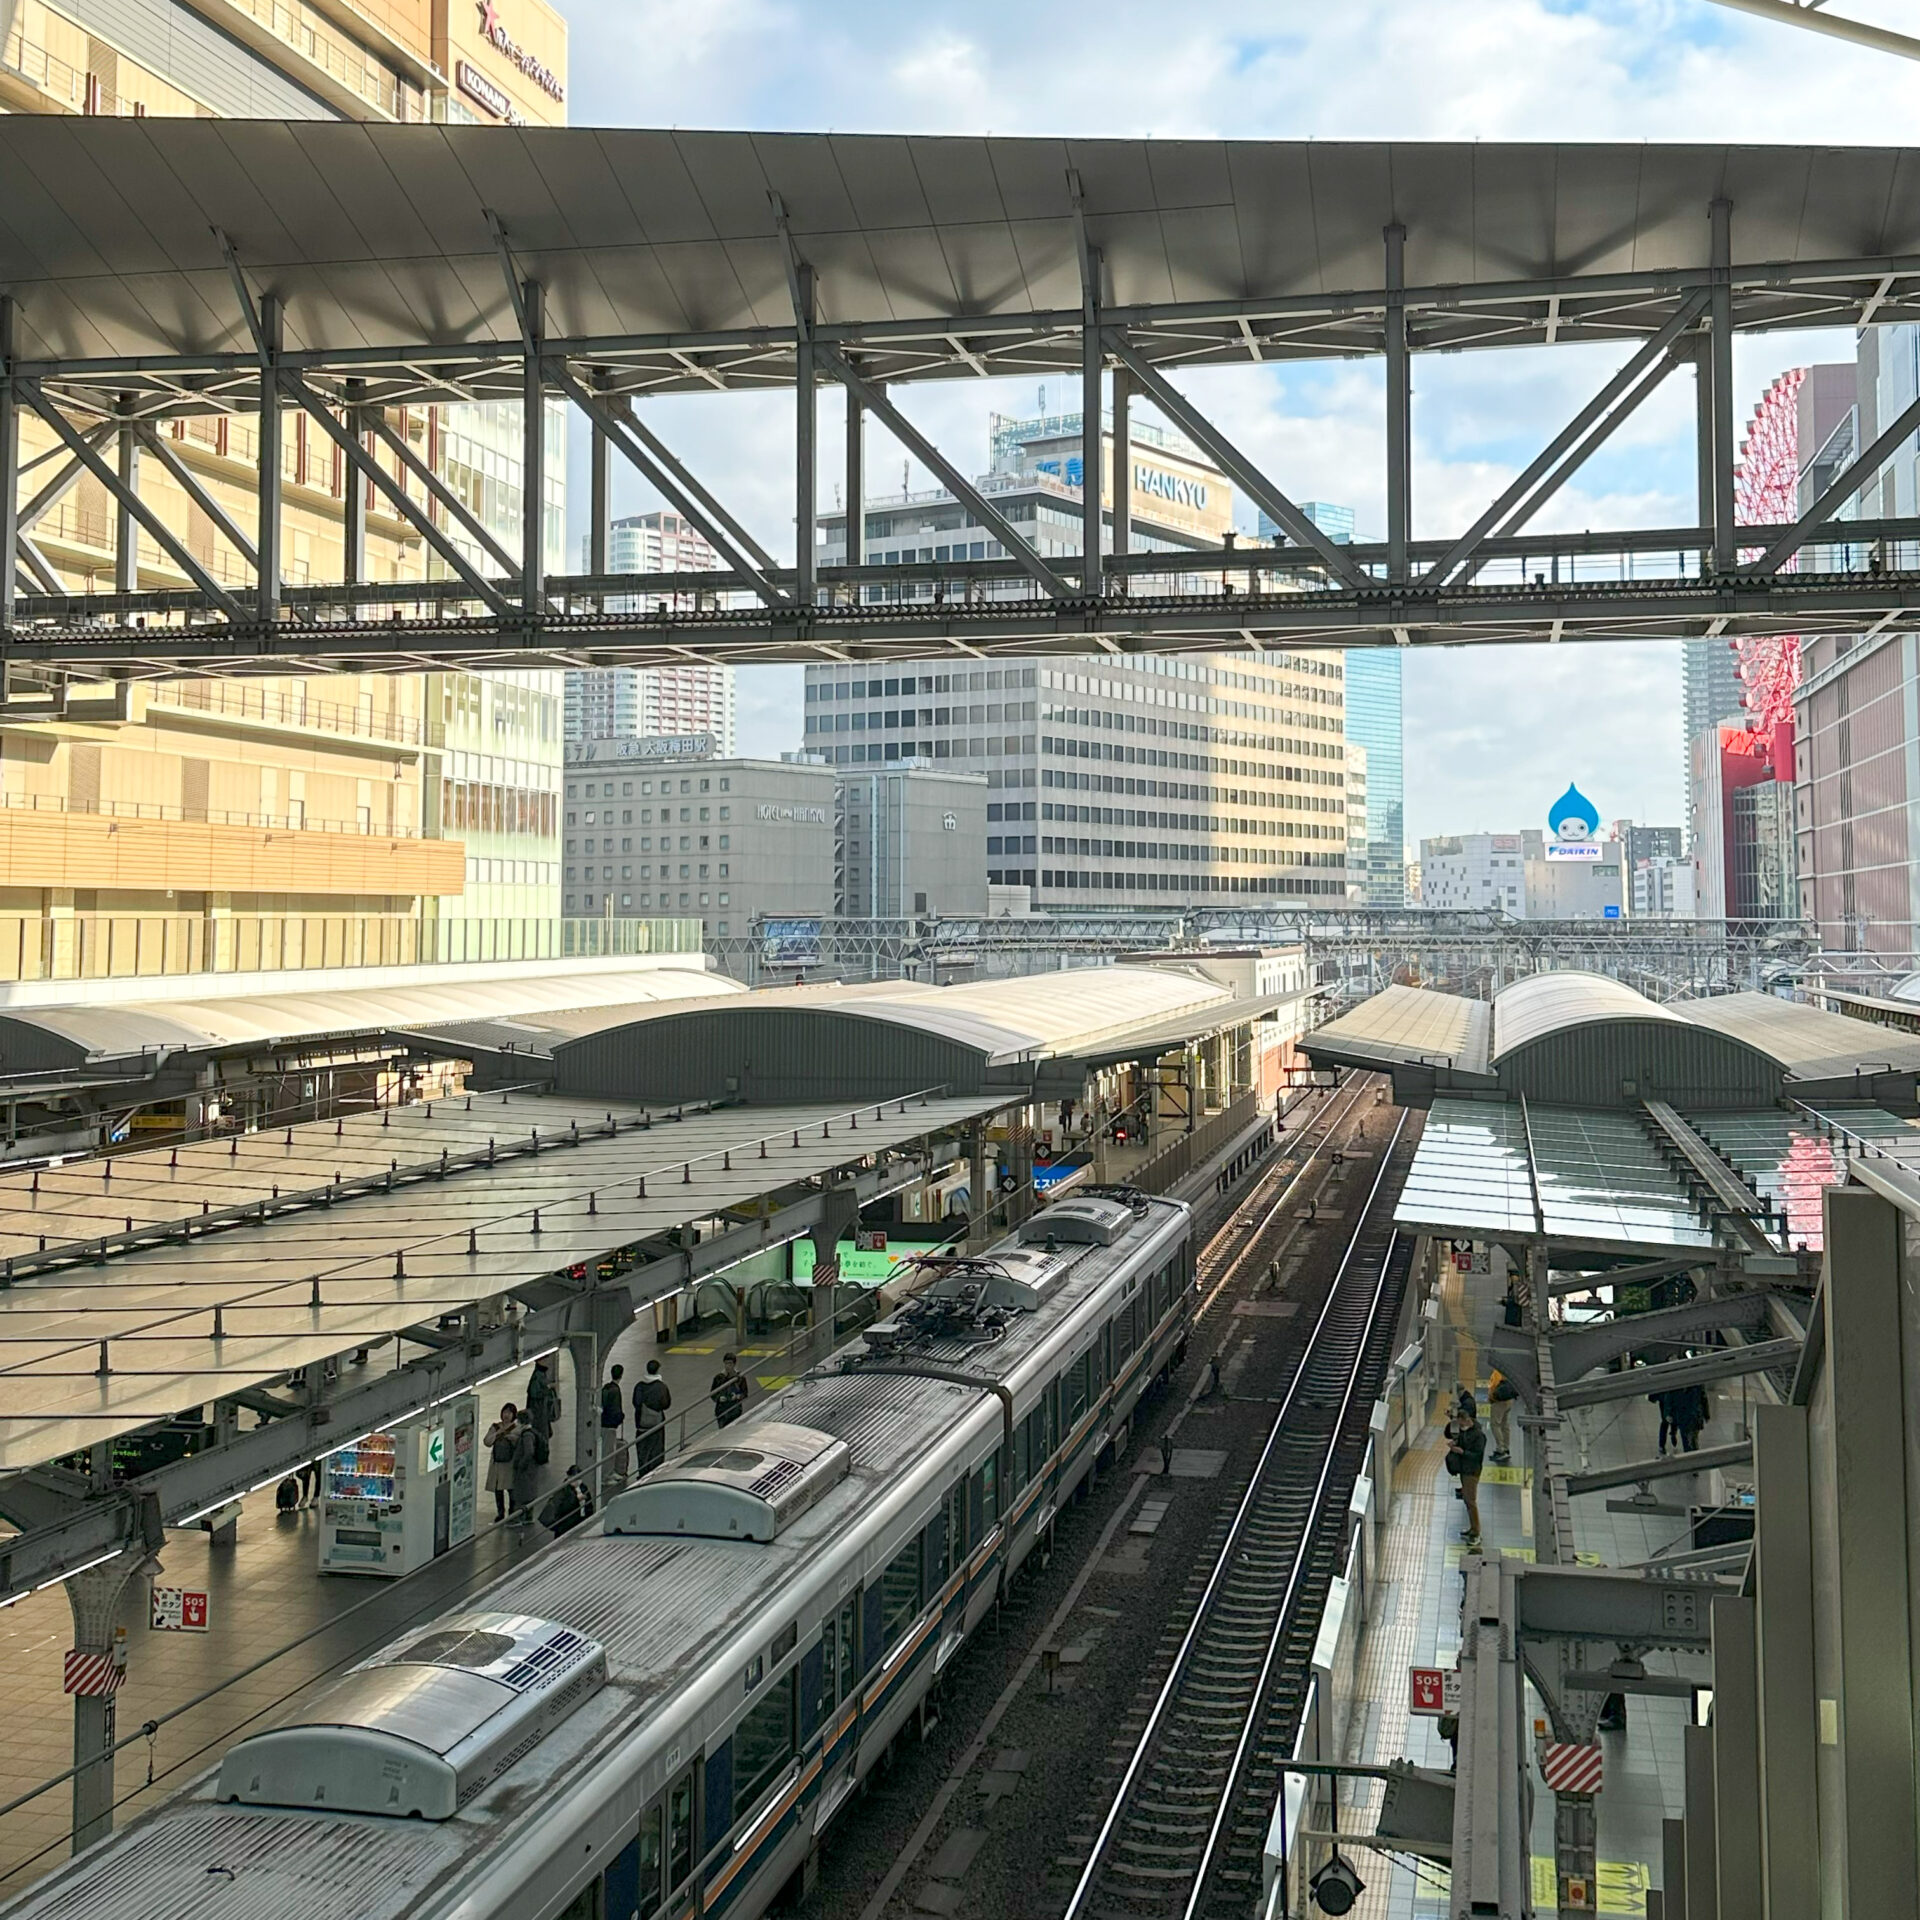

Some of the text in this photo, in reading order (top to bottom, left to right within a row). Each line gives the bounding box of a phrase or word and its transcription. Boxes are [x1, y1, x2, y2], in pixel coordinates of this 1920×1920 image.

[466, 66, 507, 115] KONAMI
[1134, 464, 1207, 511] HANKYU
[757, 803, 780, 821] HOTEL
[1558, 847, 1599, 856] DAIKIN
[185, 1597, 205, 1607] SOS
[1416, 1675, 1440, 1687] SOS
